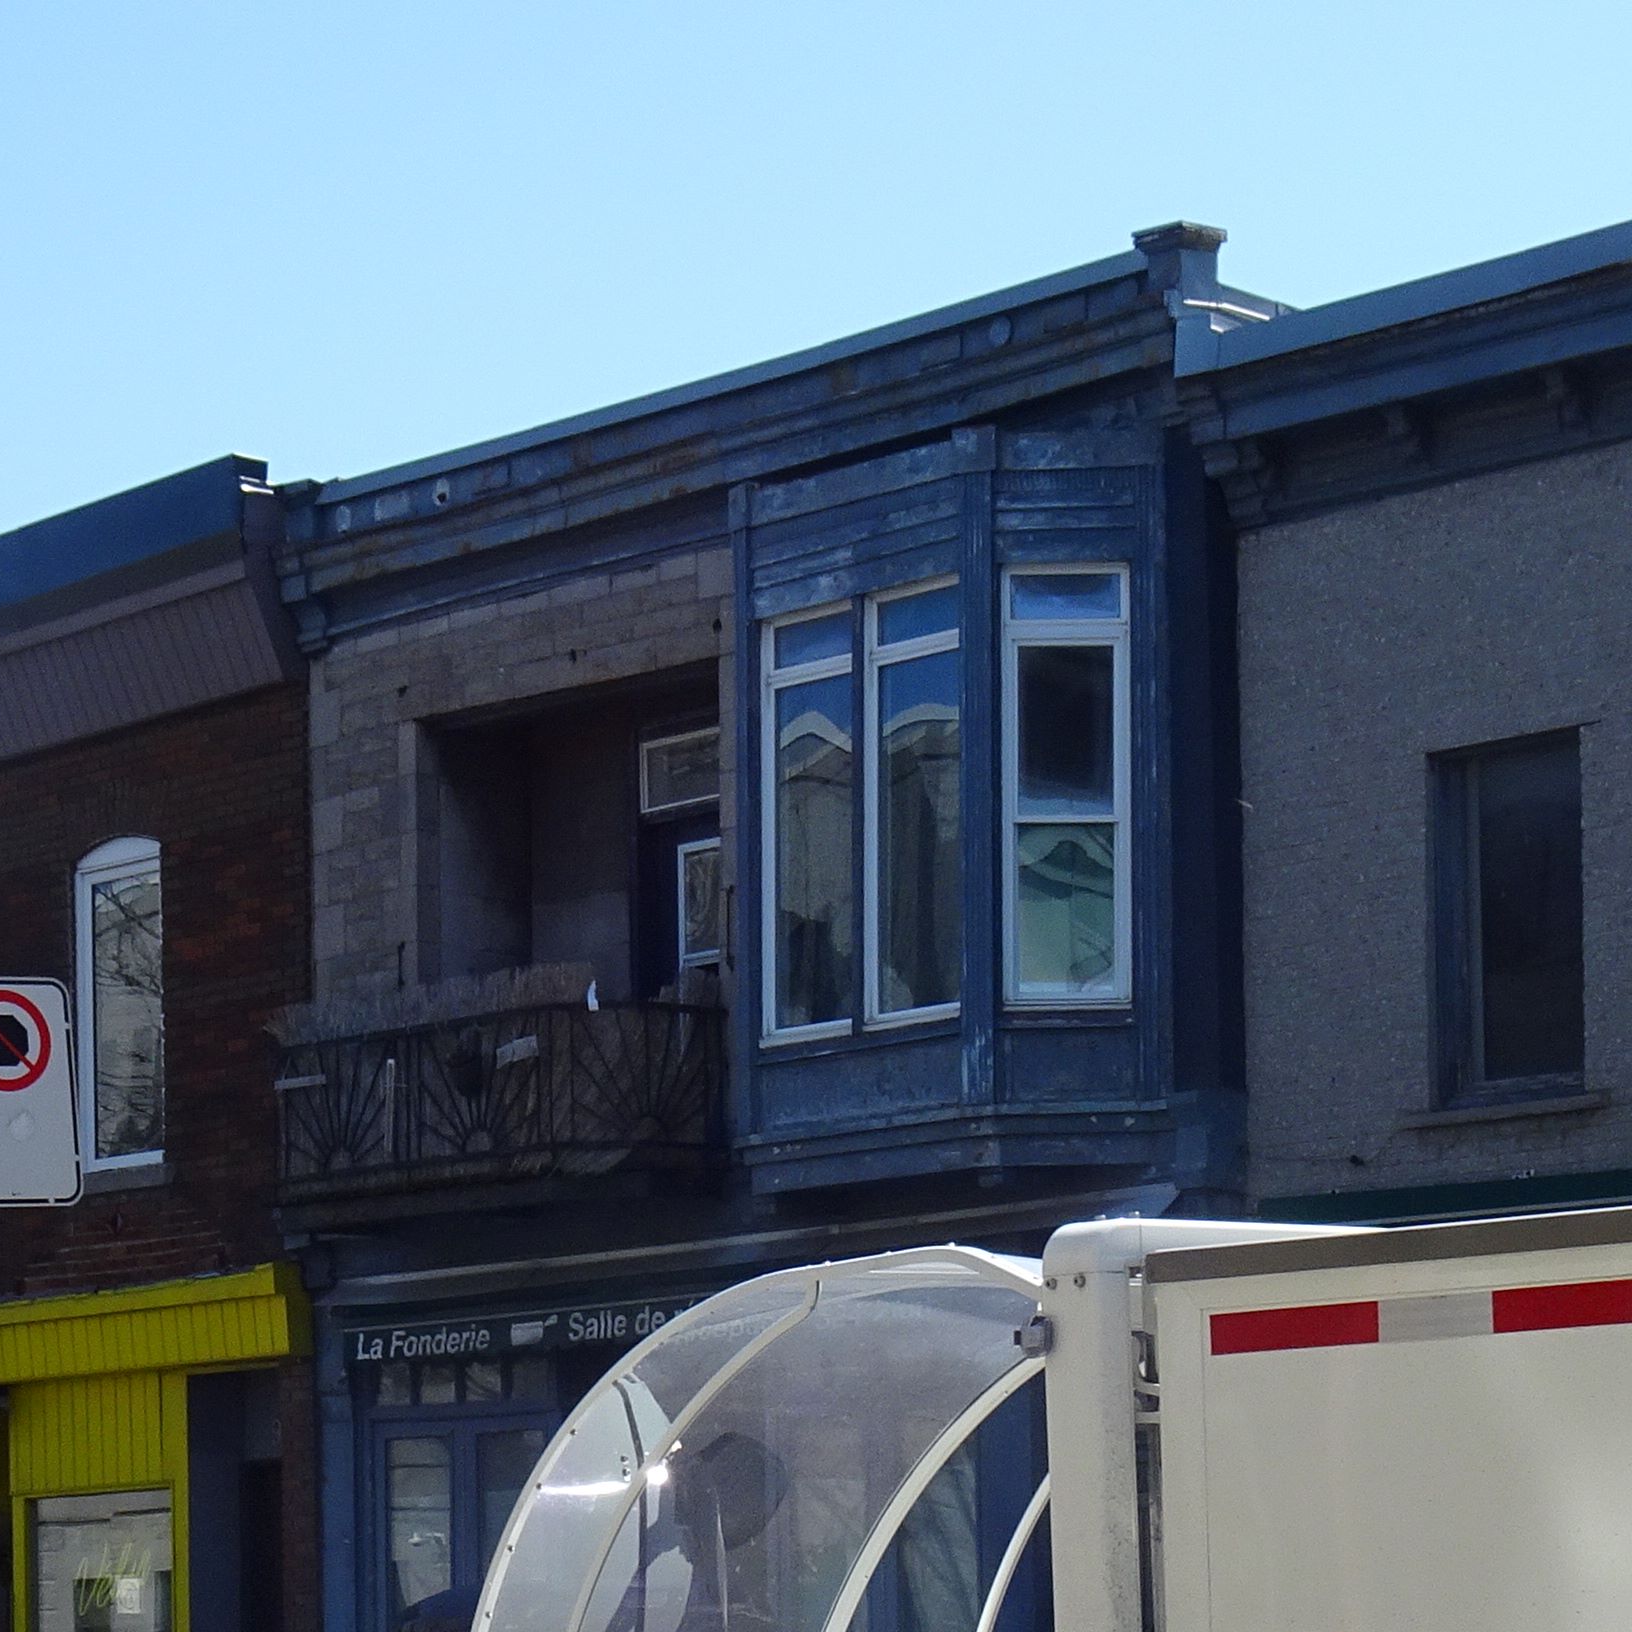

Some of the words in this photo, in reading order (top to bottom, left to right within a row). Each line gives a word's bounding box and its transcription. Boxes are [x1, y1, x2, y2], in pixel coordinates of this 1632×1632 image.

[356, 1332, 382, 1361] La
[389, 1326, 492, 1359] Fonderie
[567, 1309, 627, 1341] Salle
[635, 1305, 667, 1334] de
